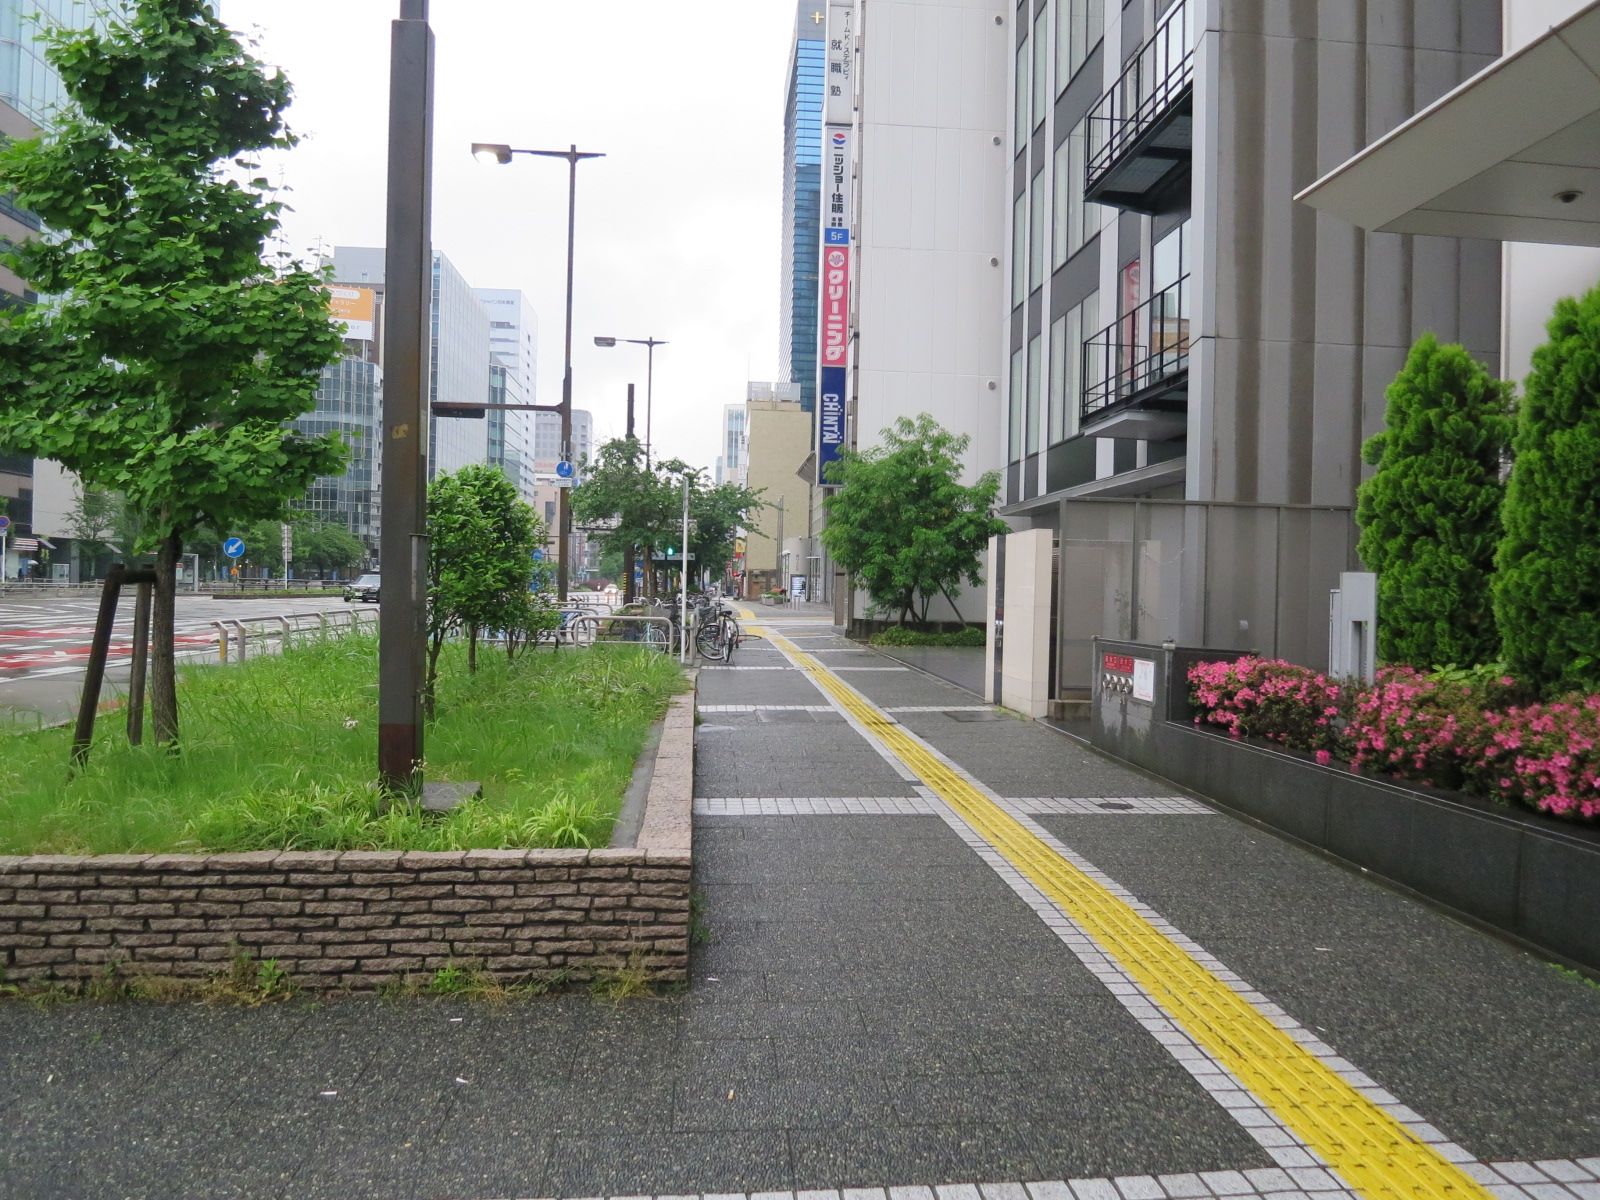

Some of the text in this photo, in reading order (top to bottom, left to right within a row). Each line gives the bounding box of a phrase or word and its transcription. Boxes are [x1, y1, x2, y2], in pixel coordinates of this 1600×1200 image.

[830, 39, 842, 97] 就職塾
[831, 232, 844, 241] 5F
[822, 393, 843, 444] CHINTAI
